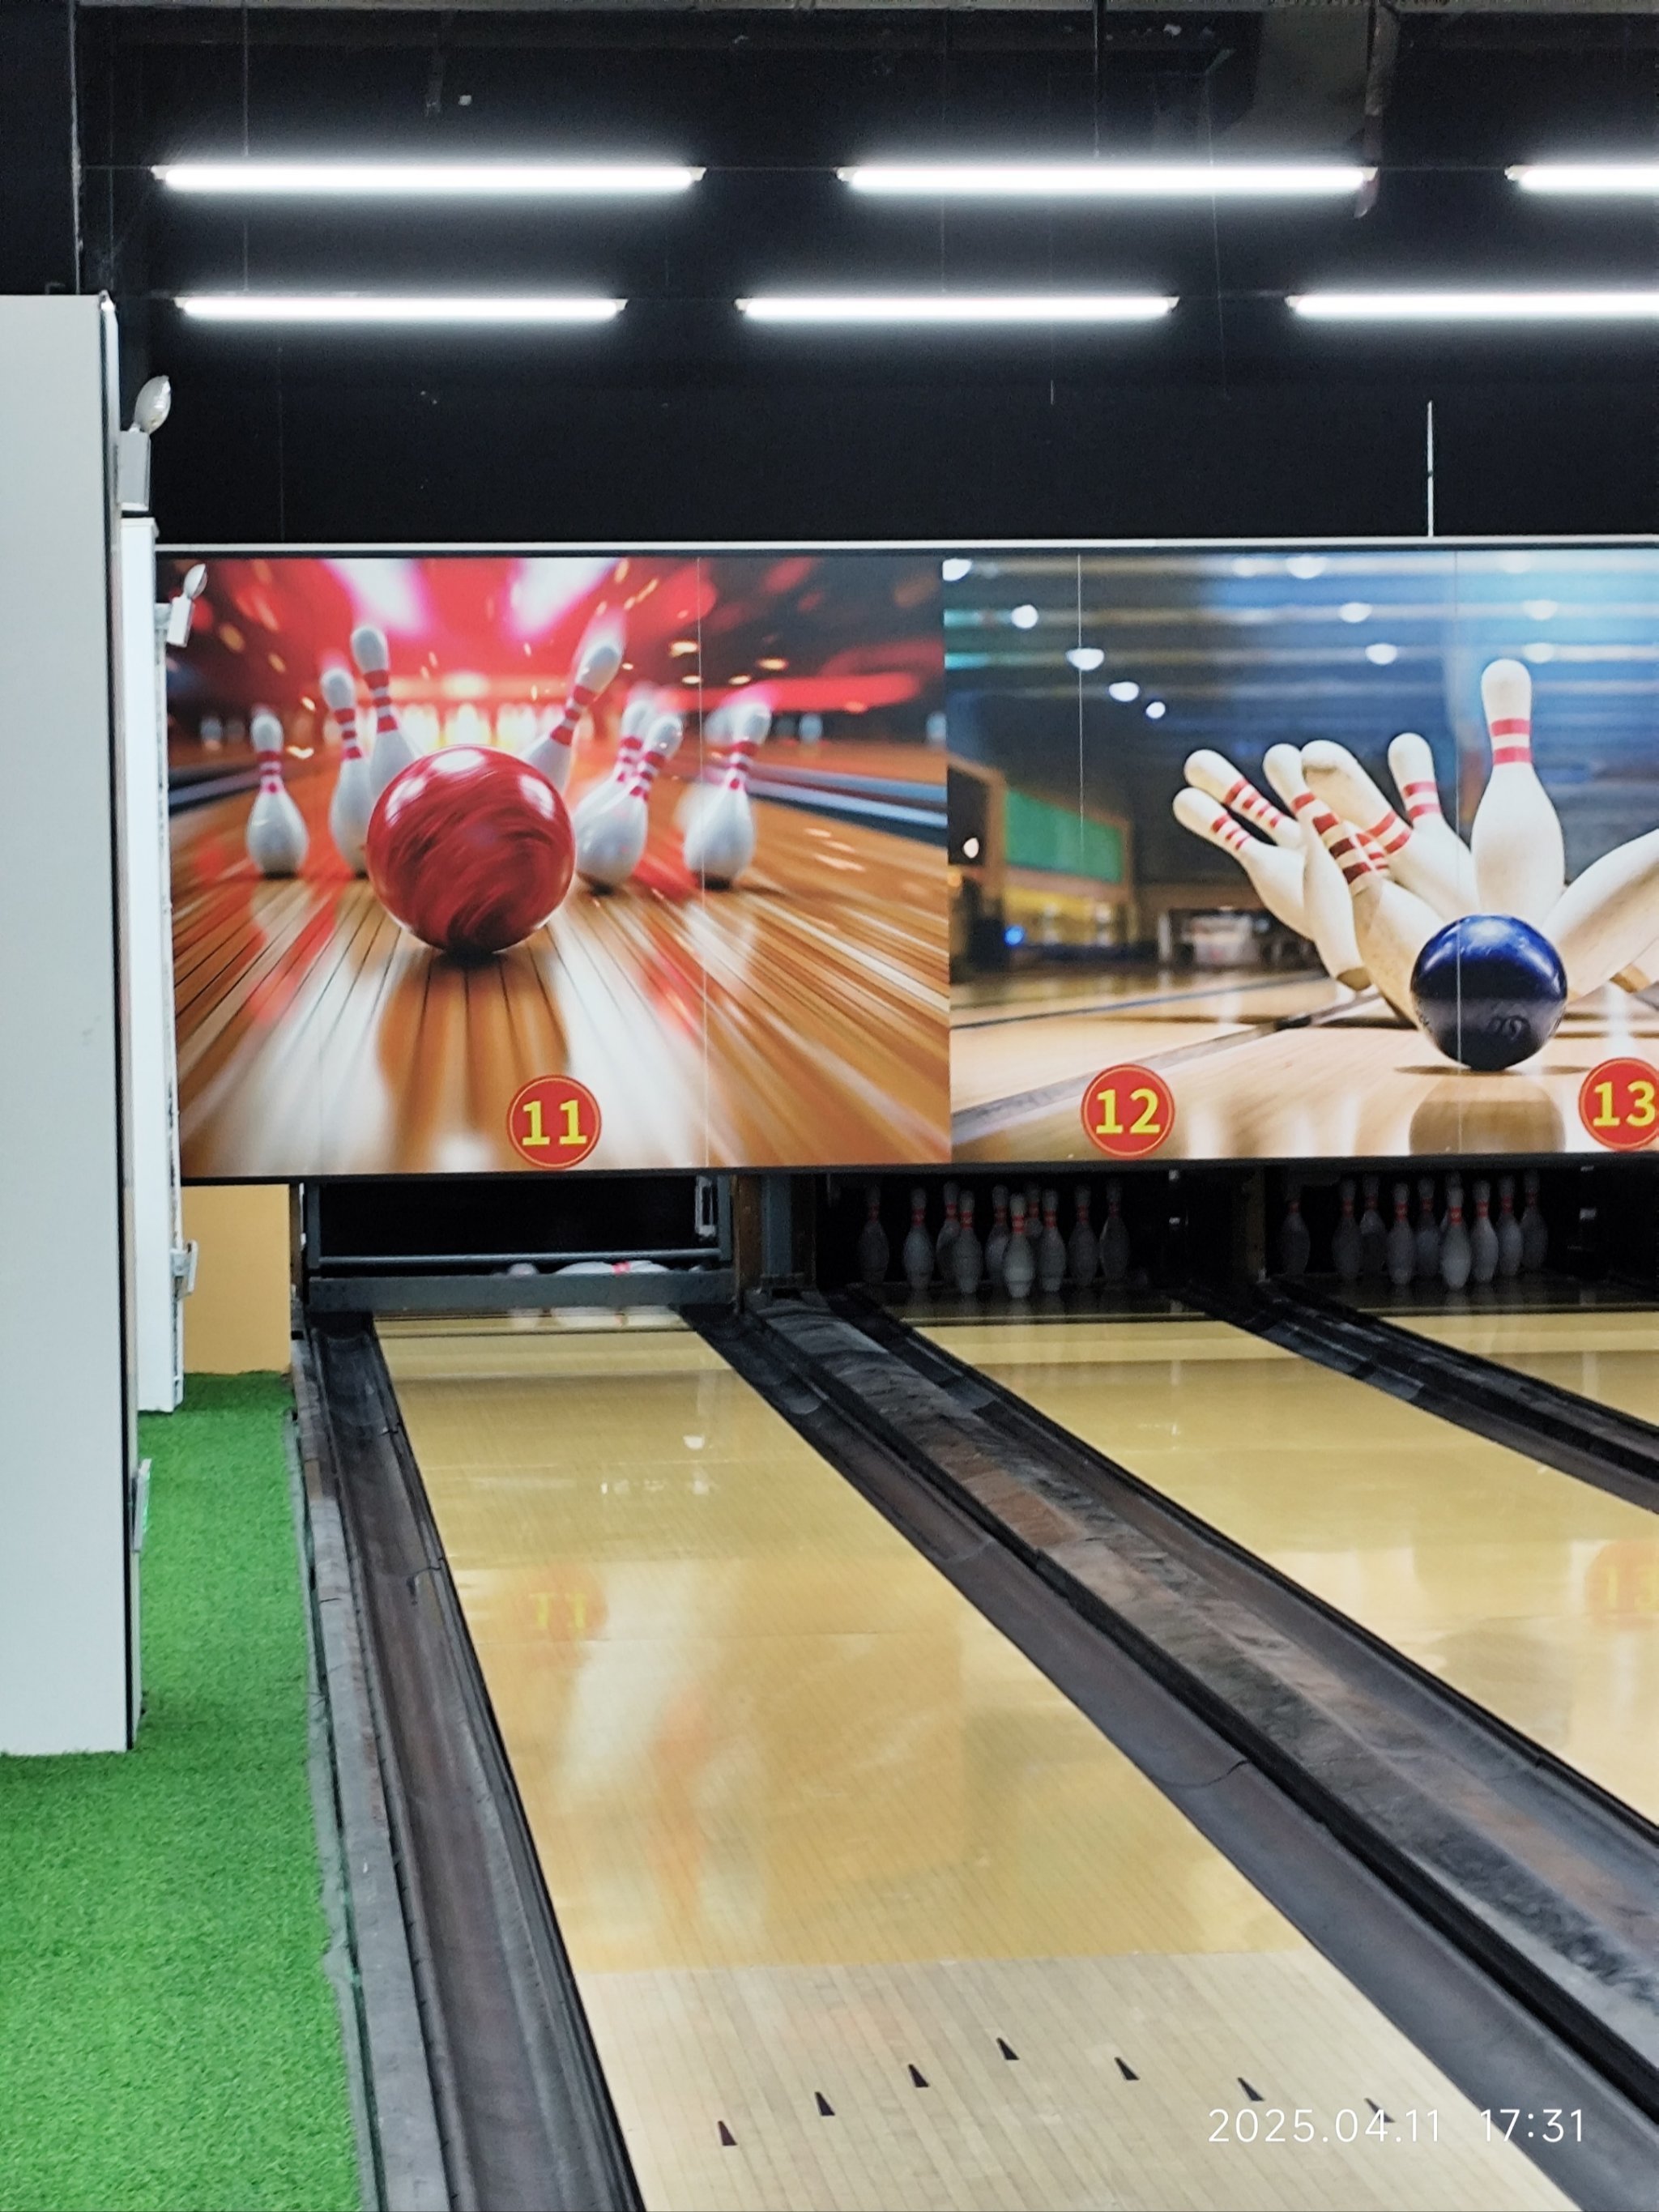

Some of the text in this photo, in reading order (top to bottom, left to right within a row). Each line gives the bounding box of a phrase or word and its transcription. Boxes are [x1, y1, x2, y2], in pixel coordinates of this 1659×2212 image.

[522, 1100, 587, 1145] 11
[1096, 1088, 1161, 1134] 12
[1593, 1080, 1656, 1127] 13
